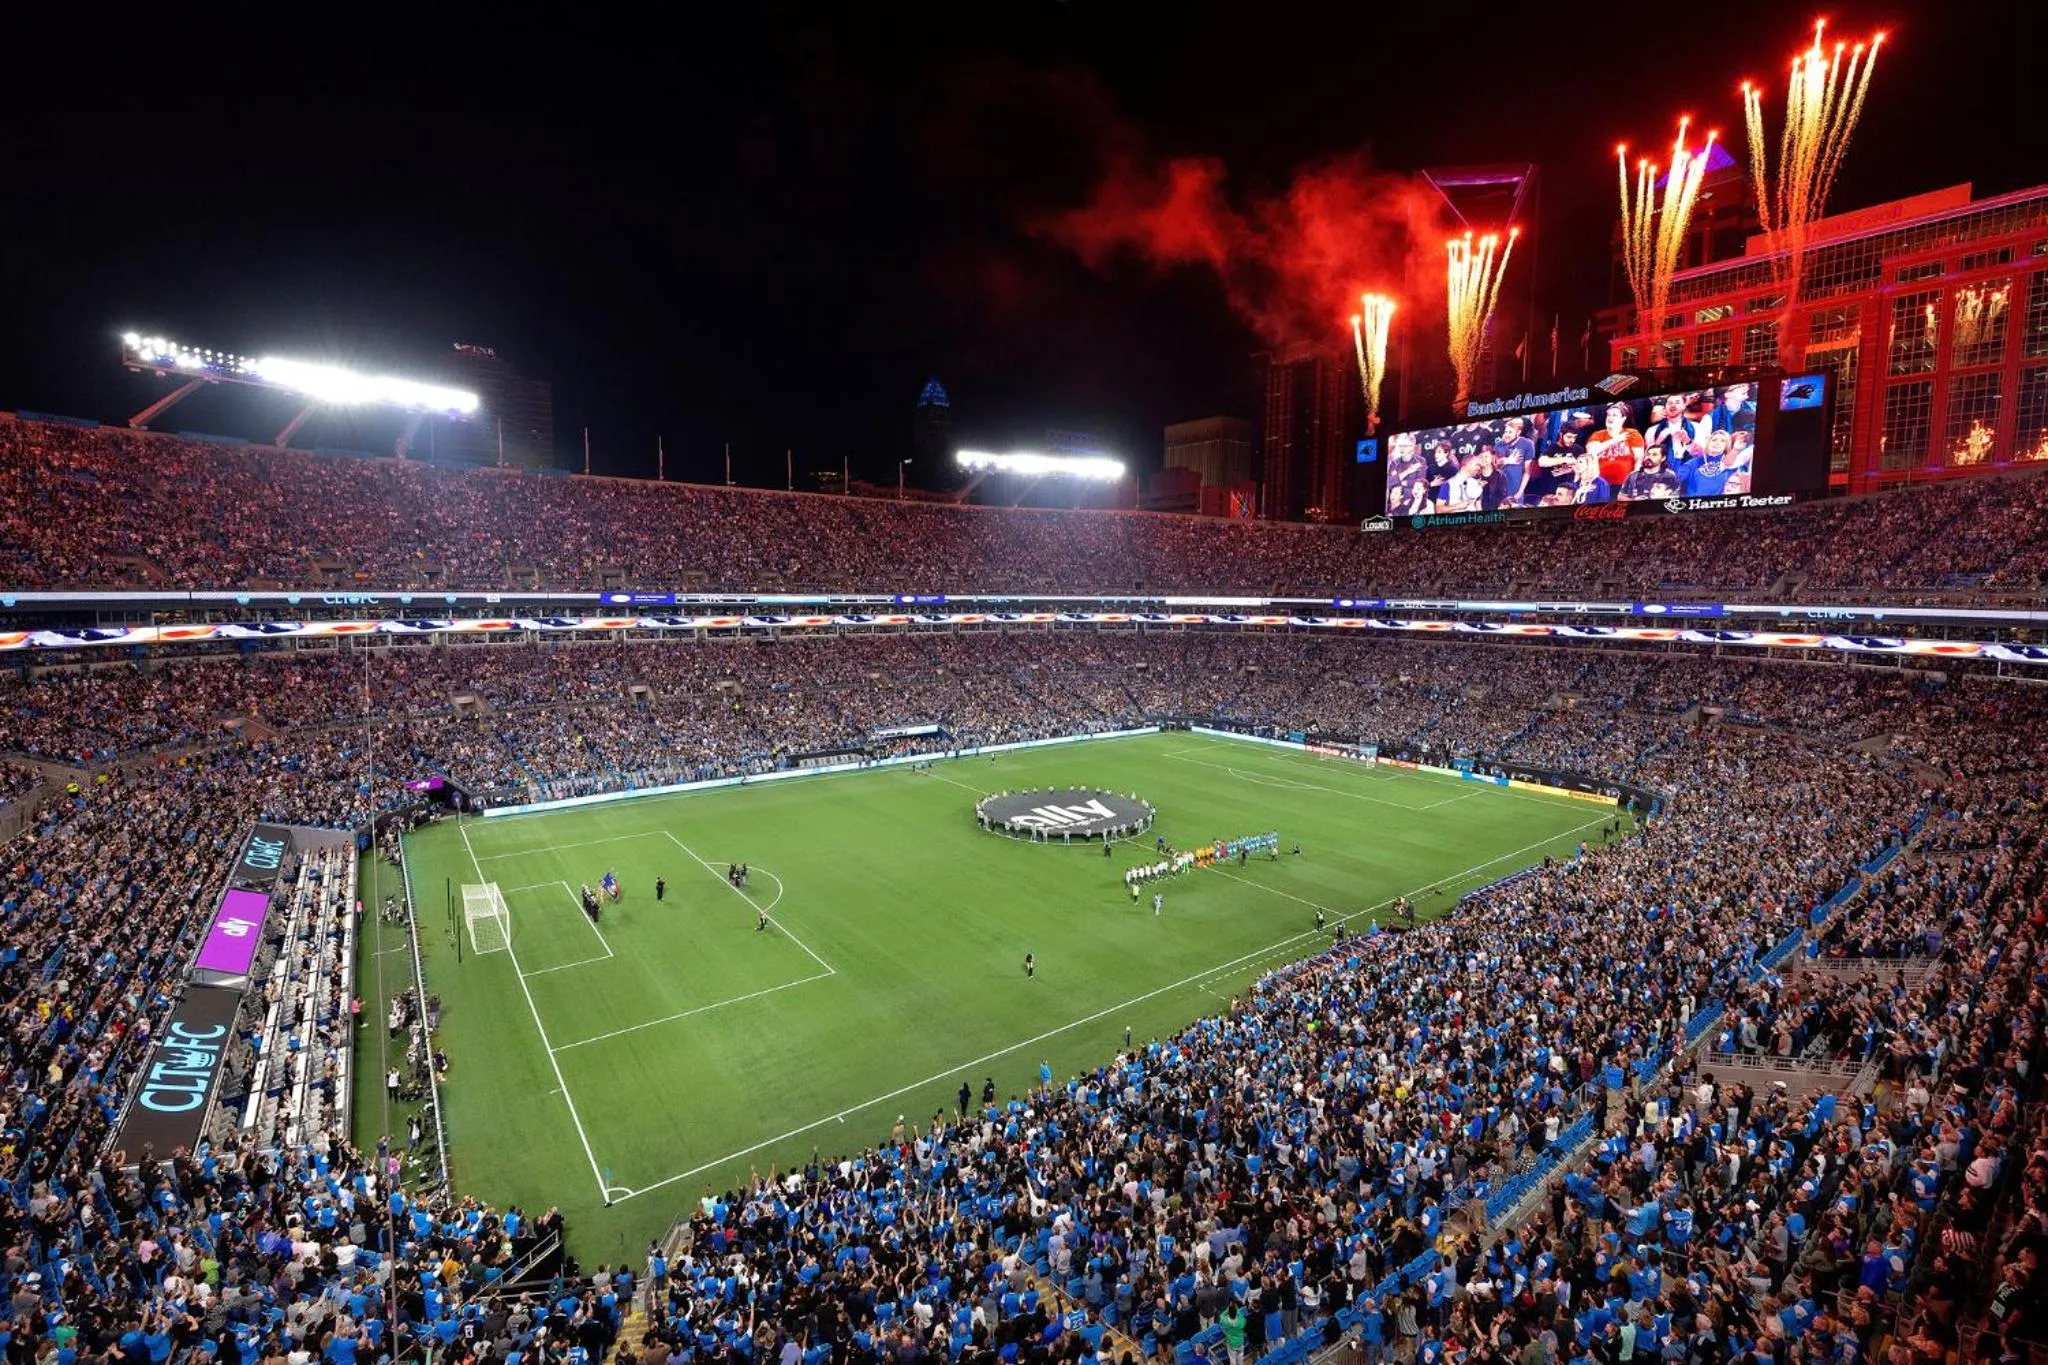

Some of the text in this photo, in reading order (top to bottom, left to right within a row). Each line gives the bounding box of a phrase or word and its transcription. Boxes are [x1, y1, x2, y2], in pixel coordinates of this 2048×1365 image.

[1467, 386, 1589, 417] Bank of America
[1688, 495, 1792, 510] Harris Teeter
[1427, 511, 1506, 527] Atrium Health
[1011, 798, 1117, 830] ally
[218, 917, 258, 937] ally
